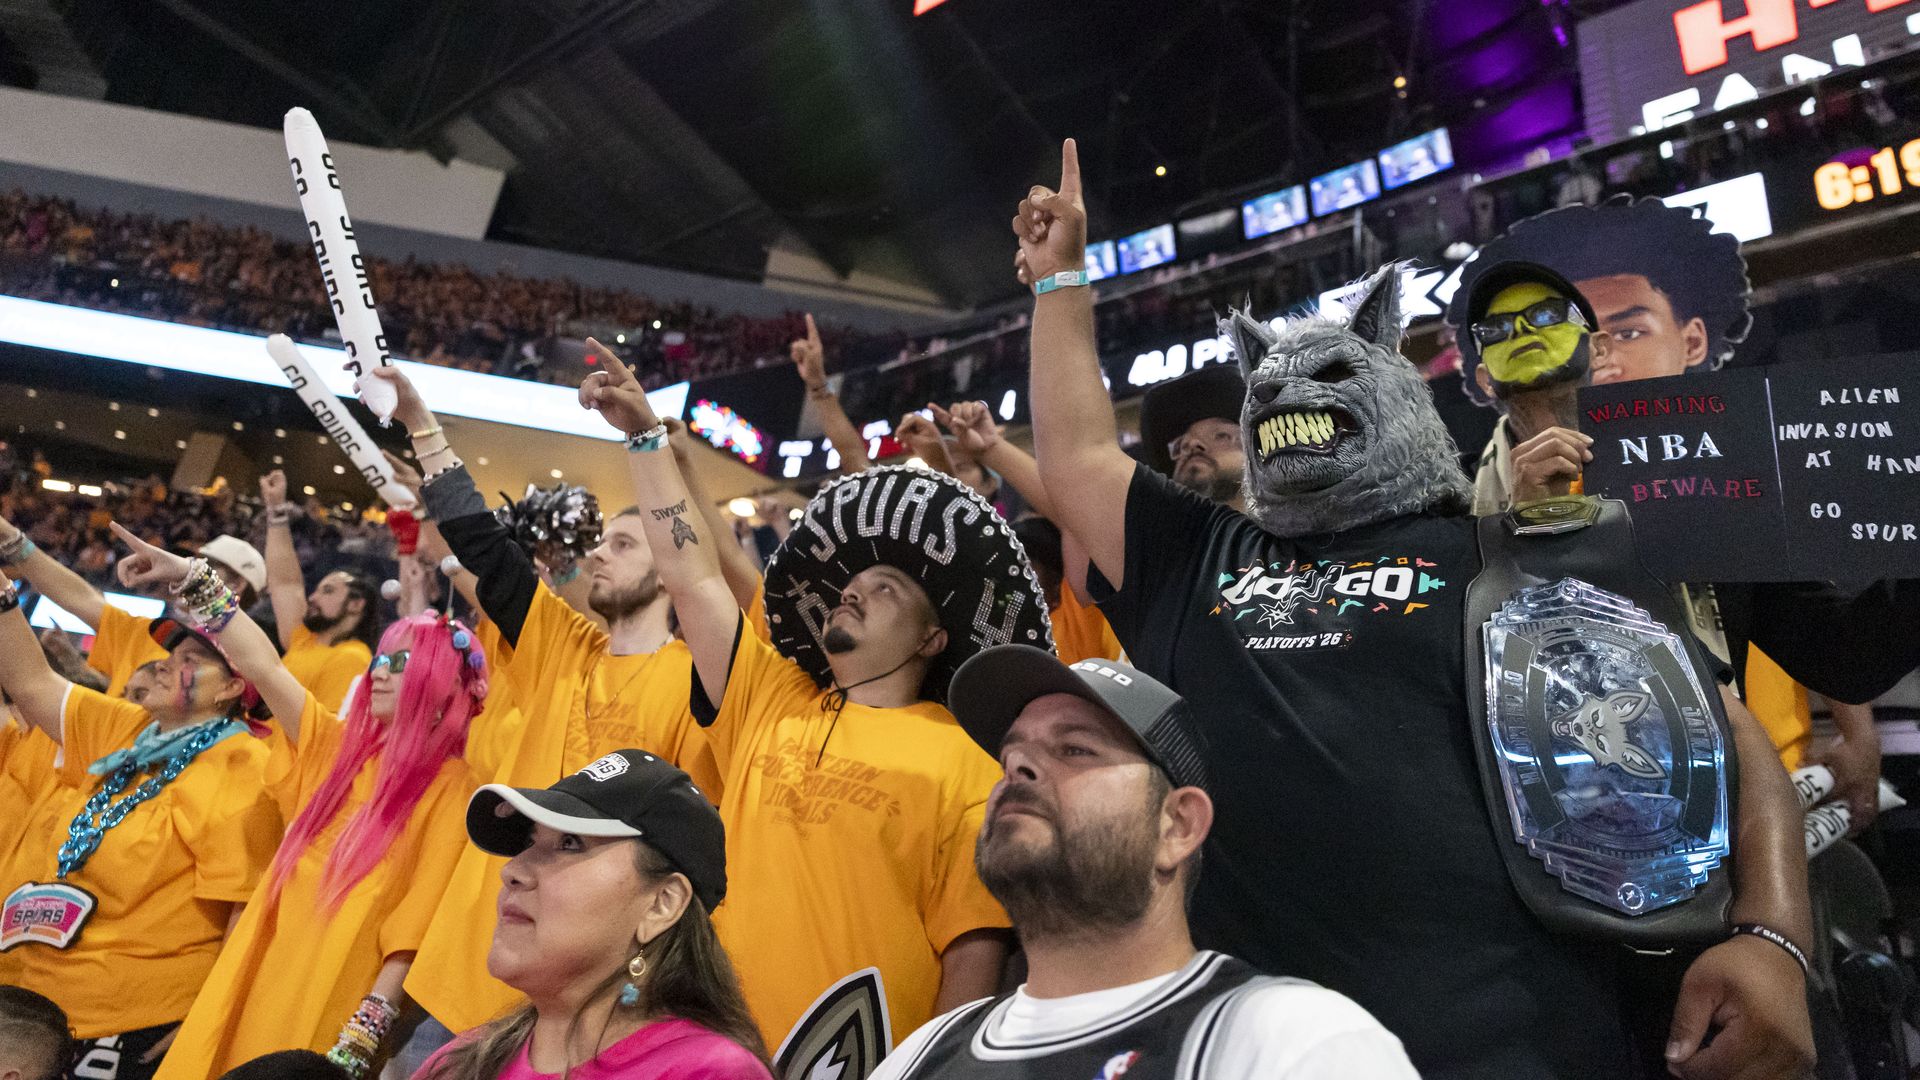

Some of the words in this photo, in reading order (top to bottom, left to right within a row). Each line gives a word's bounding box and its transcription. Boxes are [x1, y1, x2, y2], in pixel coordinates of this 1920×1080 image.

[1820, 387, 1900, 406] ALIEN
[1588, 396, 1726, 424] WARNING
[1779, 421, 1893, 441] INVASION
[1619, 431, 1724, 465] NBA
[1805, 450, 1831, 468] AT
[1632, 475, 1761, 503] BEWARE
[651, 499, 687, 521] JACKALS
[804, 474, 981, 566] SPURS
[1810, 502, 1841, 519] GO
[1333, 566, 1414, 601] GO
[1245, 635, 1317, 650] PLAYOFFS
[1319, 632, 1343, 647] '26
[1681, 706, 1714, 768] JACKAL
[1762, 928, 1785, 945] SAN
